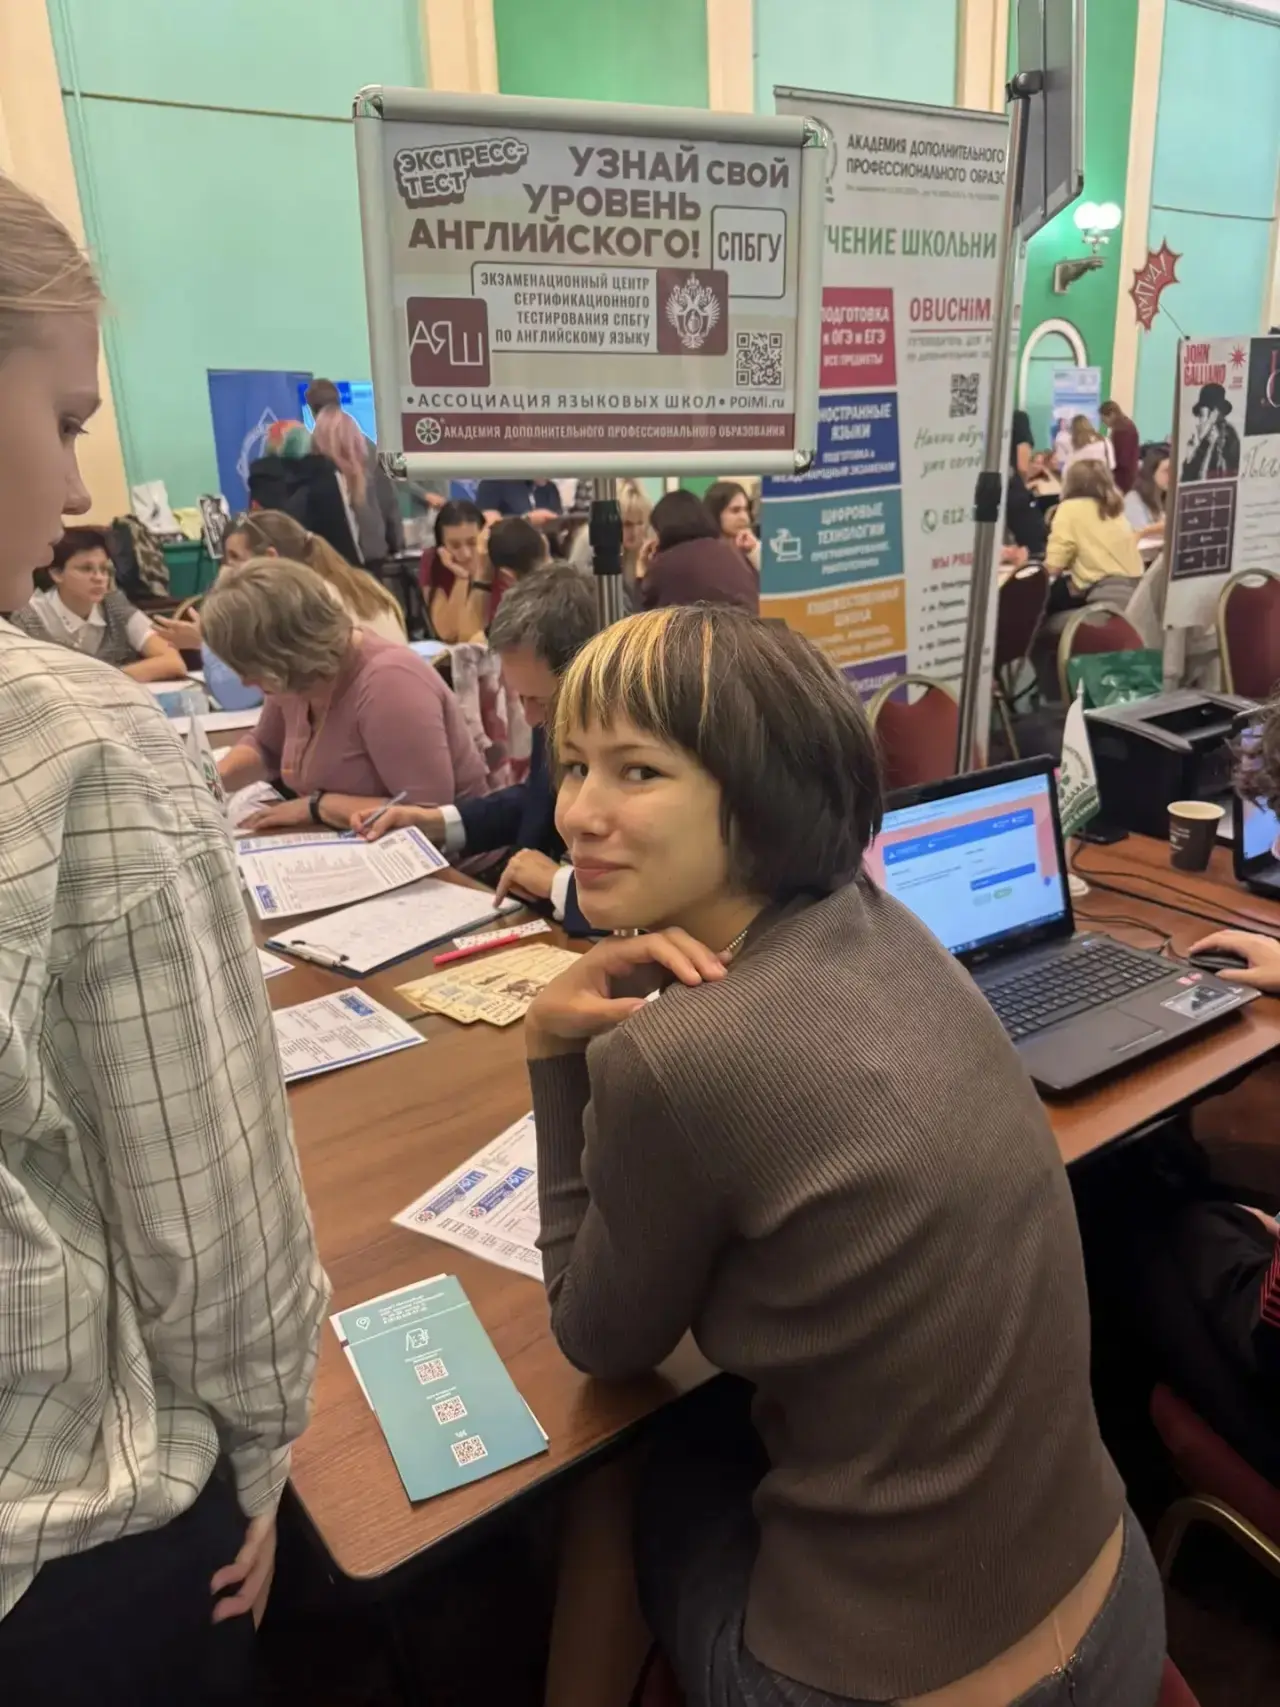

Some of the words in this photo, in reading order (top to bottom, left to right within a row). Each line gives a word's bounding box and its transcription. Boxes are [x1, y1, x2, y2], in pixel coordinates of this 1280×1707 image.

[400, 141, 527, 173] ЭКСПРЕСС-
[847, 134, 907, 154] АКАДЕМИЯ
[910, 140, 1005, 163] ДОПОЛНИТЕЛЬНОГО
[569, 144, 699, 184] УЗНАЙ
[706, 157, 790, 188] СВОЙ
[846, 158, 966, 182] ПРОФЕССИОНАЛЬНОГО
[405, 172, 464, 197] ТЕСТ
[523, 183, 701, 221] УРОВЕНЬ
[408, 215, 700, 258] АНГЛИЙСКОГО!
[717, 231, 782, 263] СПБГУ
[825, 225, 897, 255] ЧЕНИЕ
[480, 272, 608, 290] ЭКЗАМЕНАЦИОННЫЙ
[612, 276, 650, 292] ЦЕНТР
[514, 292, 650, 309] СЕРТИФИКАЦИОННОГО
[517, 310, 609, 327] ТЕСТИРОВАНИЯ
[613, 313, 650, 328] СПБГУ
[495, 329, 512, 343] ПО
[516, 328, 605, 346] АНГЛИЙСКОМУ
[609, 331, 650, 347] ЯЗЫКУ
[832, 329, 853, 346] ОГЭ
[864, 328, 886, 345] ЕГЭ
[1184, 344, 1210, 364] JOHN
[1184, 364, 1226, 386] GALLIANO
[418, 393, 551, 410] АССОЦИАЦИЯ
[557, 395, 659, 408] ЯЗЫКОВЫХ
[665, 395, 715, 409] ШКОЛ
[819, 402, 892, 422] НОСТРАННЫЕ
[444, 425, 500, 440] АКАДЕМИЯ
[504, 425, 604, 439] ДОПОЛНИТЕЛЬНОГО
[607, 425, 717, 438] ПРОФЕССИОНАЛЬНОГО
[719, 425, 785, 438] ОБРАЗОВАНИЯ
